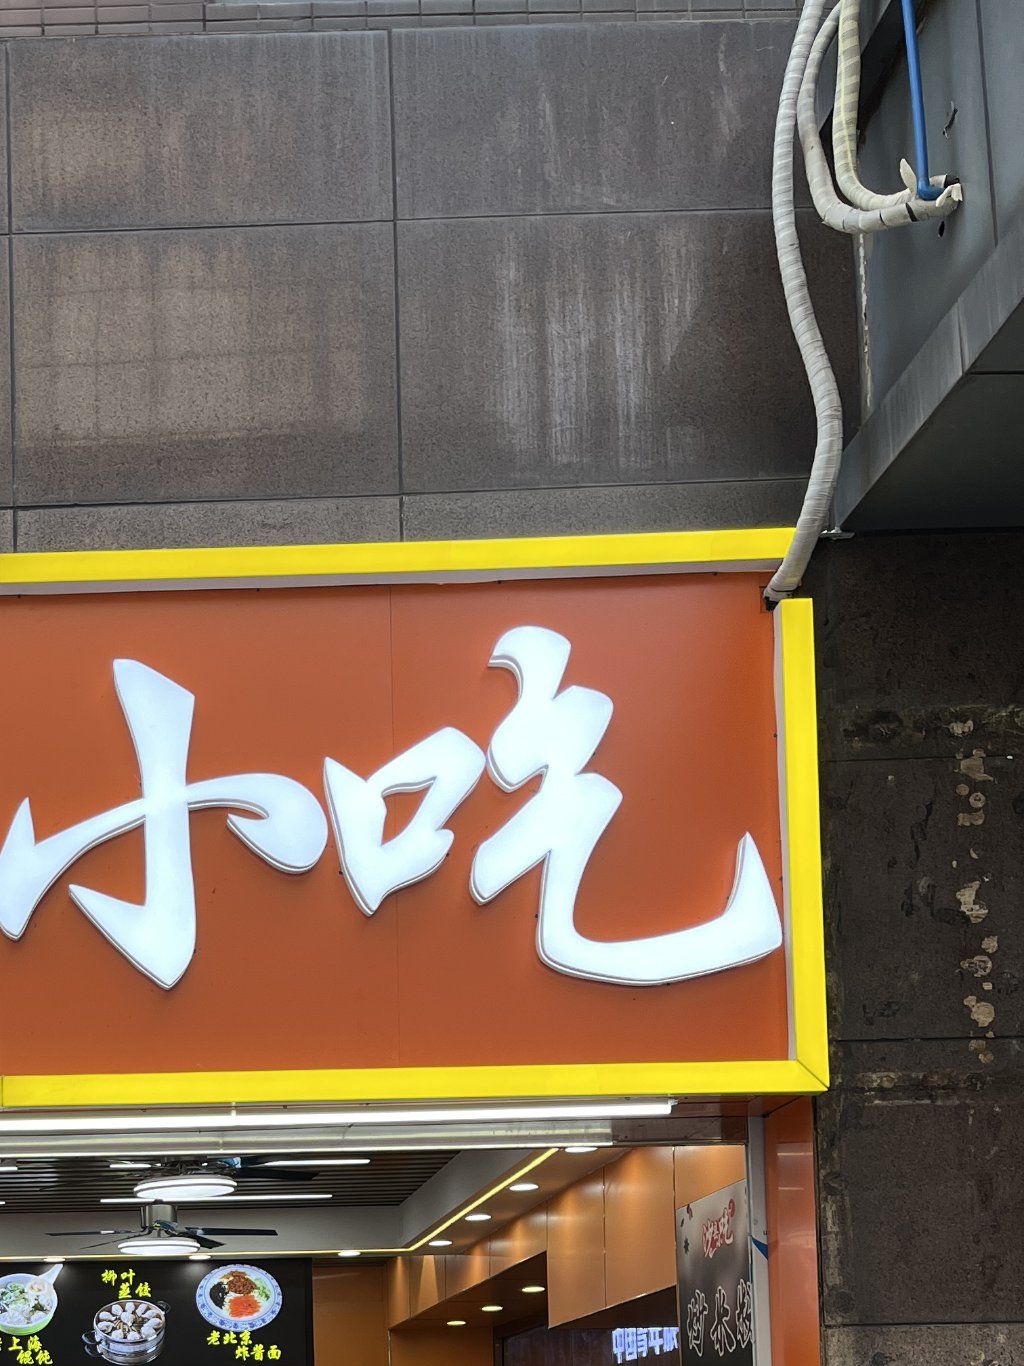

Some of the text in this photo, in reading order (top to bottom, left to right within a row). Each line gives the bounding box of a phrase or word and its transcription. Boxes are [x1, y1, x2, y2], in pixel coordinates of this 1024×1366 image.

[101, 1269, 136, 1286] 柳叶
[118, 1282, 152, 1299] 蒸饺
[207, 1330, 253, 1345] 老北京
[16, 1350, 53, 1365] 馄饨
[235, 1344, 281, 1361] 炸酱面
